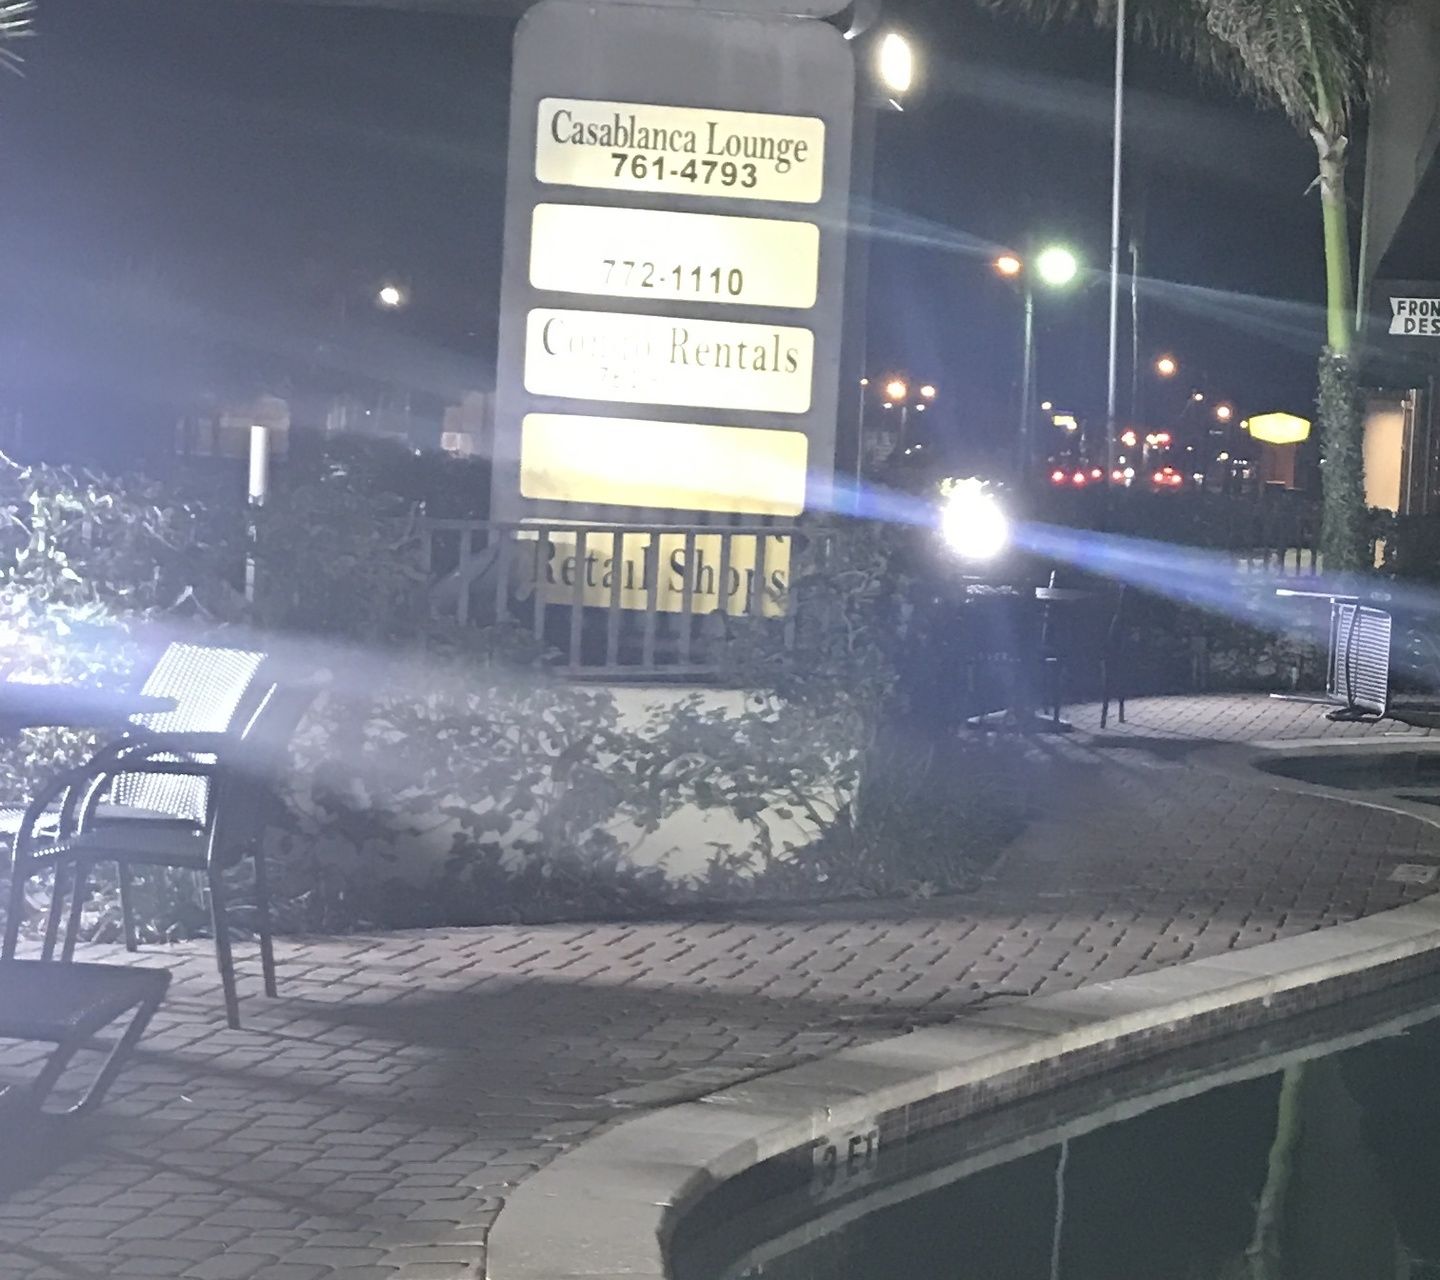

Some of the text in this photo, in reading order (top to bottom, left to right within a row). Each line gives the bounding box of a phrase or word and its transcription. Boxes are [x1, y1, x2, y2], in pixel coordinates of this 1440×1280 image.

[550, 108, 809, 173] Casablanca Lounge
[611, 152, 758, 188] 761-4793
[602, 258, 744, 297] 772-1110
[669, 327, 800, 374] Rentals
